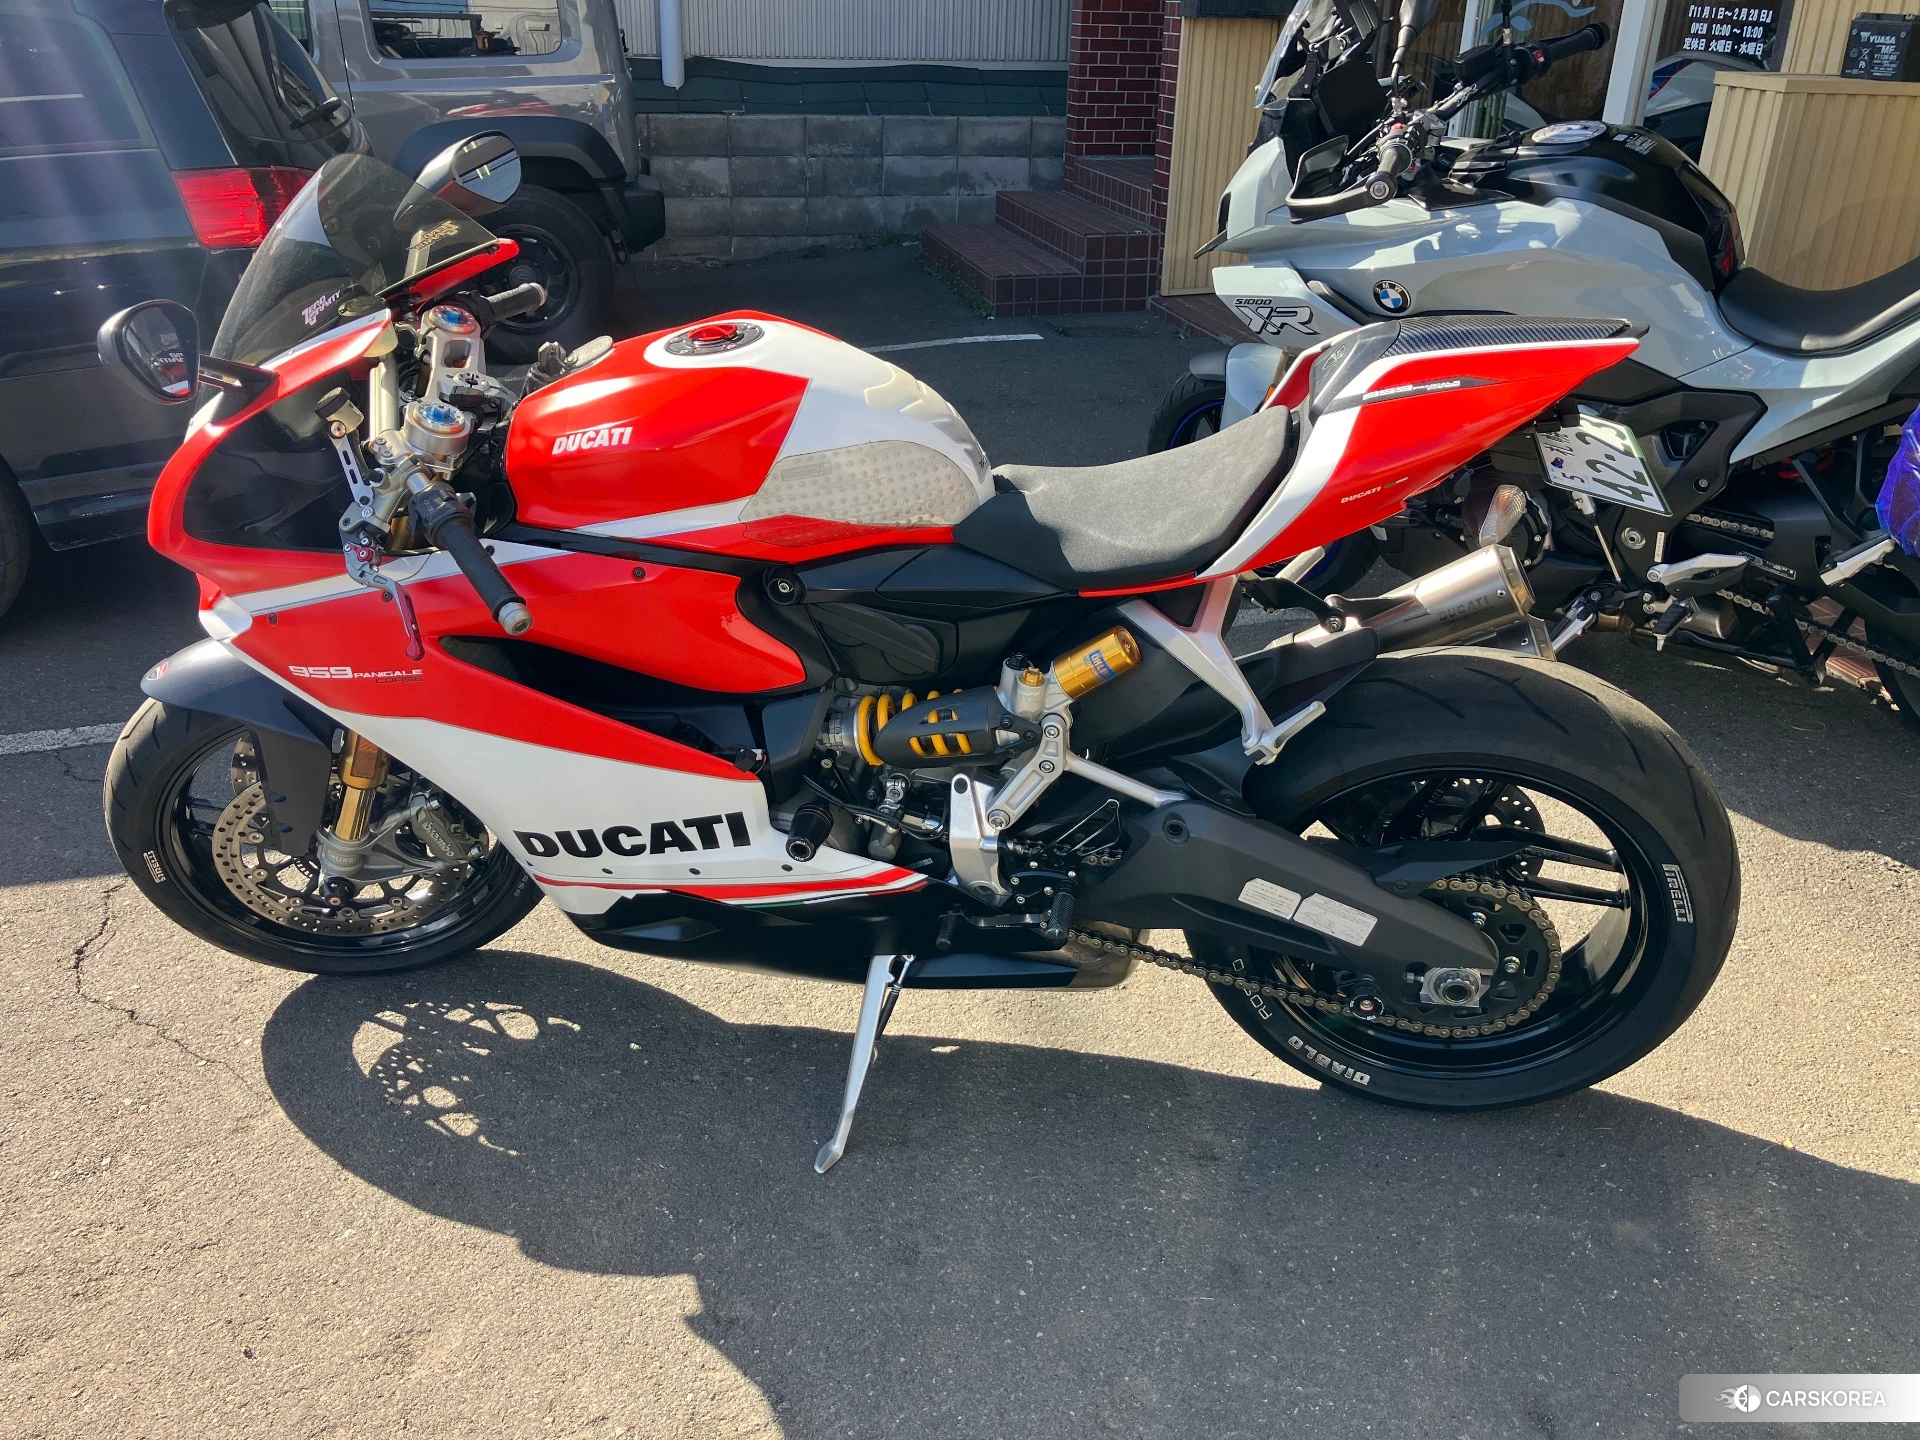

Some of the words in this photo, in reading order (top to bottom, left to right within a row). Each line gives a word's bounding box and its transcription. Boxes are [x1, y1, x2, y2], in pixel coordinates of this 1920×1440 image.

[1690, 22, 1708, 35] OPEN
[1711, 23, 1731, 37] 10:00
[1742, 25, 1763, 39] 18:00
[1869, 35, 1896, 45] YUASA
[1683, 37, 1706, 51] 定休日
[1881, 45, 1896, 55] MF
[1375, 282, 1403, 295] BMW
[301, 295, 326, 325] ZERO
[308, 289, 341, 326] GRAVITY
[1234, 297, 1273, 306] S1000
[1235, 305, 1322, 336] XR
[551, 426, 634, 456] DUCATI
[1340, 485, 1382, 504] DUCATI
[1439, 595, 1489, 621] DUCATI
[288, 665, 353, 679] 959
[353, 668, 423, 679] PANIGALE
[375, 675, 423, 684] CORSE
[422, 821, 455, 857] brembo
[513, 811, 752, 859] DUCATI
[1661, 863, 1694, 924] PIRELLI
[1287, 1035, 1371, 1086] DIABLO
